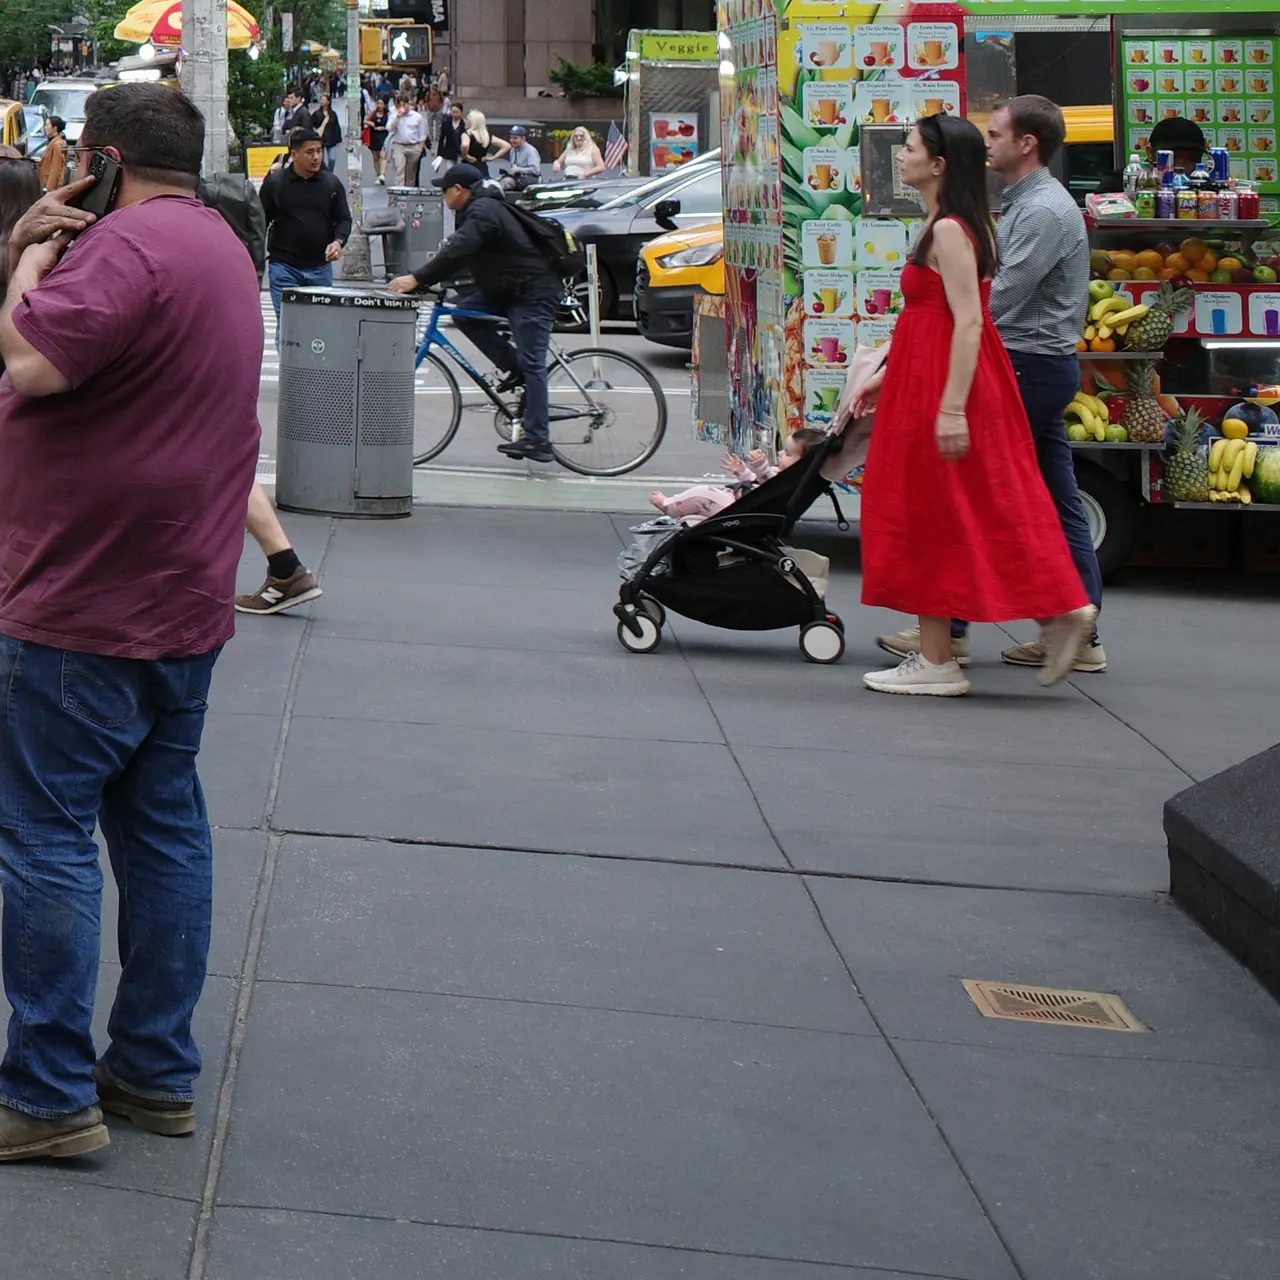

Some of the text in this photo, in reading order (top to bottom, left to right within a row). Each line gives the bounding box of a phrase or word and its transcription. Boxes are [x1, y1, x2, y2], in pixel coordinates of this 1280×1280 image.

[656, 41, 709, 55] Veggie
[1178, 200, 1197, 208] FAN
[354, 297, 381, 307] Don't
